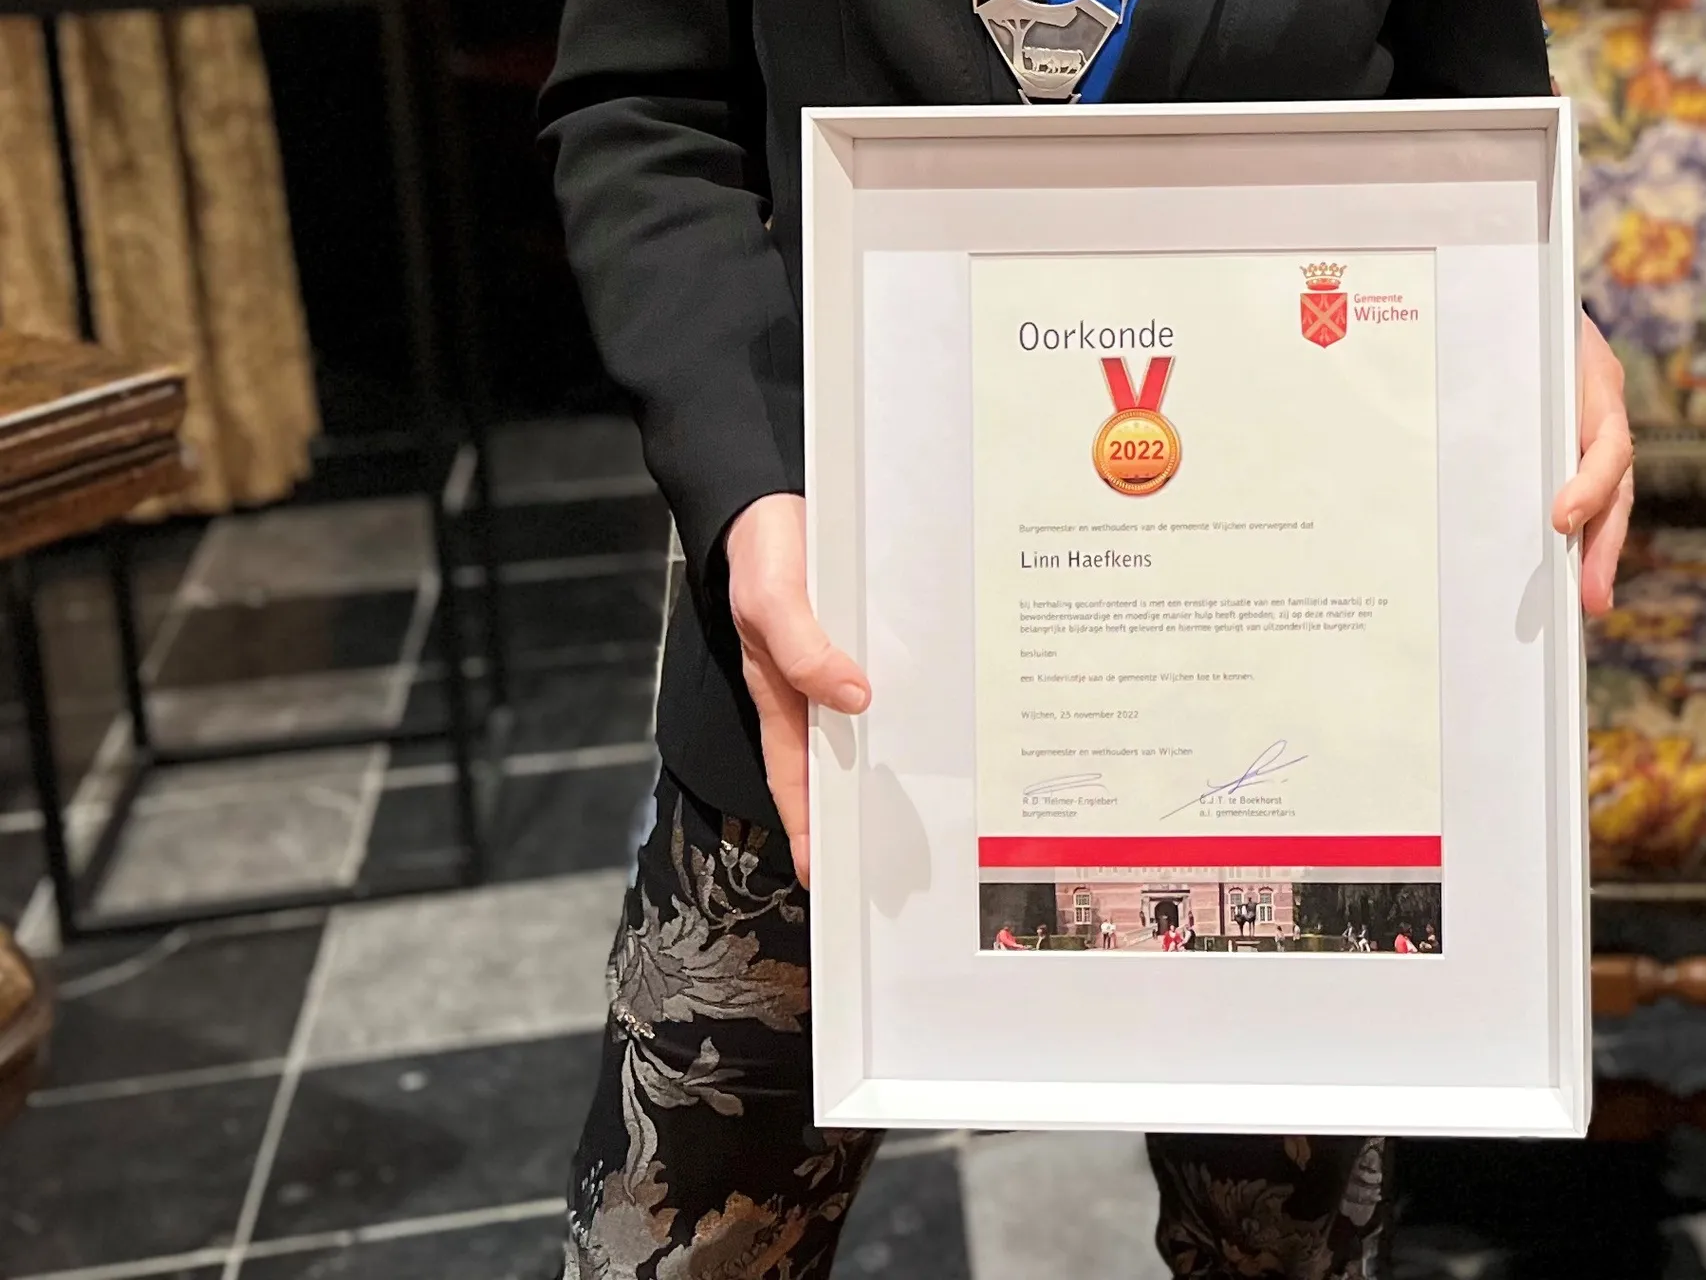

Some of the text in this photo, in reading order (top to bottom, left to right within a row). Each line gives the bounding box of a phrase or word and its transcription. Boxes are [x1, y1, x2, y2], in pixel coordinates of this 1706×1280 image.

[1354, 293, 1403, 304] Gemeente
[1354, 305, 1419, 322] Wijchen
[1019, 319, 1174, 351] Oorkonde
[1109, 440, 1164, 460] 2022
[1019, 524, 1075, 534] Burgemeester
[1091, 523, 1138, 531] wethouders
[1157, 523, 1167, 531] de
[1170, 523, 1209, 532] gemeente
[1213, 522, 1246, 531] Wijchen
[1249, 521, 1298, 531] overwegend
[1300, 521, 1314, 530] dat
[1021, 550, 1152, 568] Linn Haefkens
[1019, 600, 1030, 610] bij
[1033, 600, 1072, 610] herhaling
[1075, 599, 1137, 609] geconfronteerd
[1220, 598, 1251, 607] situatie
[1288, 597, 1328, 606] familielid
[1331, 597, 1362, 607] waarbij
[1378, 598, 1388, 607] op
[1194, 611, 1213, 620] hulp
[1215, 610, 1236, 619] heeft
[1292, 611, 1302, 620] op
[1305, 610, 1323, 618] deze
[1020, 624, 1066, 634] belangrijke
[1069, 624, 1103, 634] bijdrage
[1105, 623, 1126, 632] heeft
[1129, 623, 1164, 633] geleverd
[1263, 622, 1321, 632] uitzonderlijke
[1089, 674, 1103, 682] van
[1105, 674, 1116, 682] de
[1118, 673, 1157, 683] gemeente
[1160, 673, 1194, 683] Wijchen
[1197, 673, 1210, 681] toe
[1212, 673, 1221, 681] te
[1074, 710, 1114, 719] november
[1117, 710, 1139, 719] 2022
[1021, 748, 1076, 757] burgemeester
[1091, 747, 1138, 756] wethouders
[1159, 747, 1193, 757] Wijchen
[1228, 796, 1237, 805] te
[1240, 796, 1282, 805] Boekhorst
